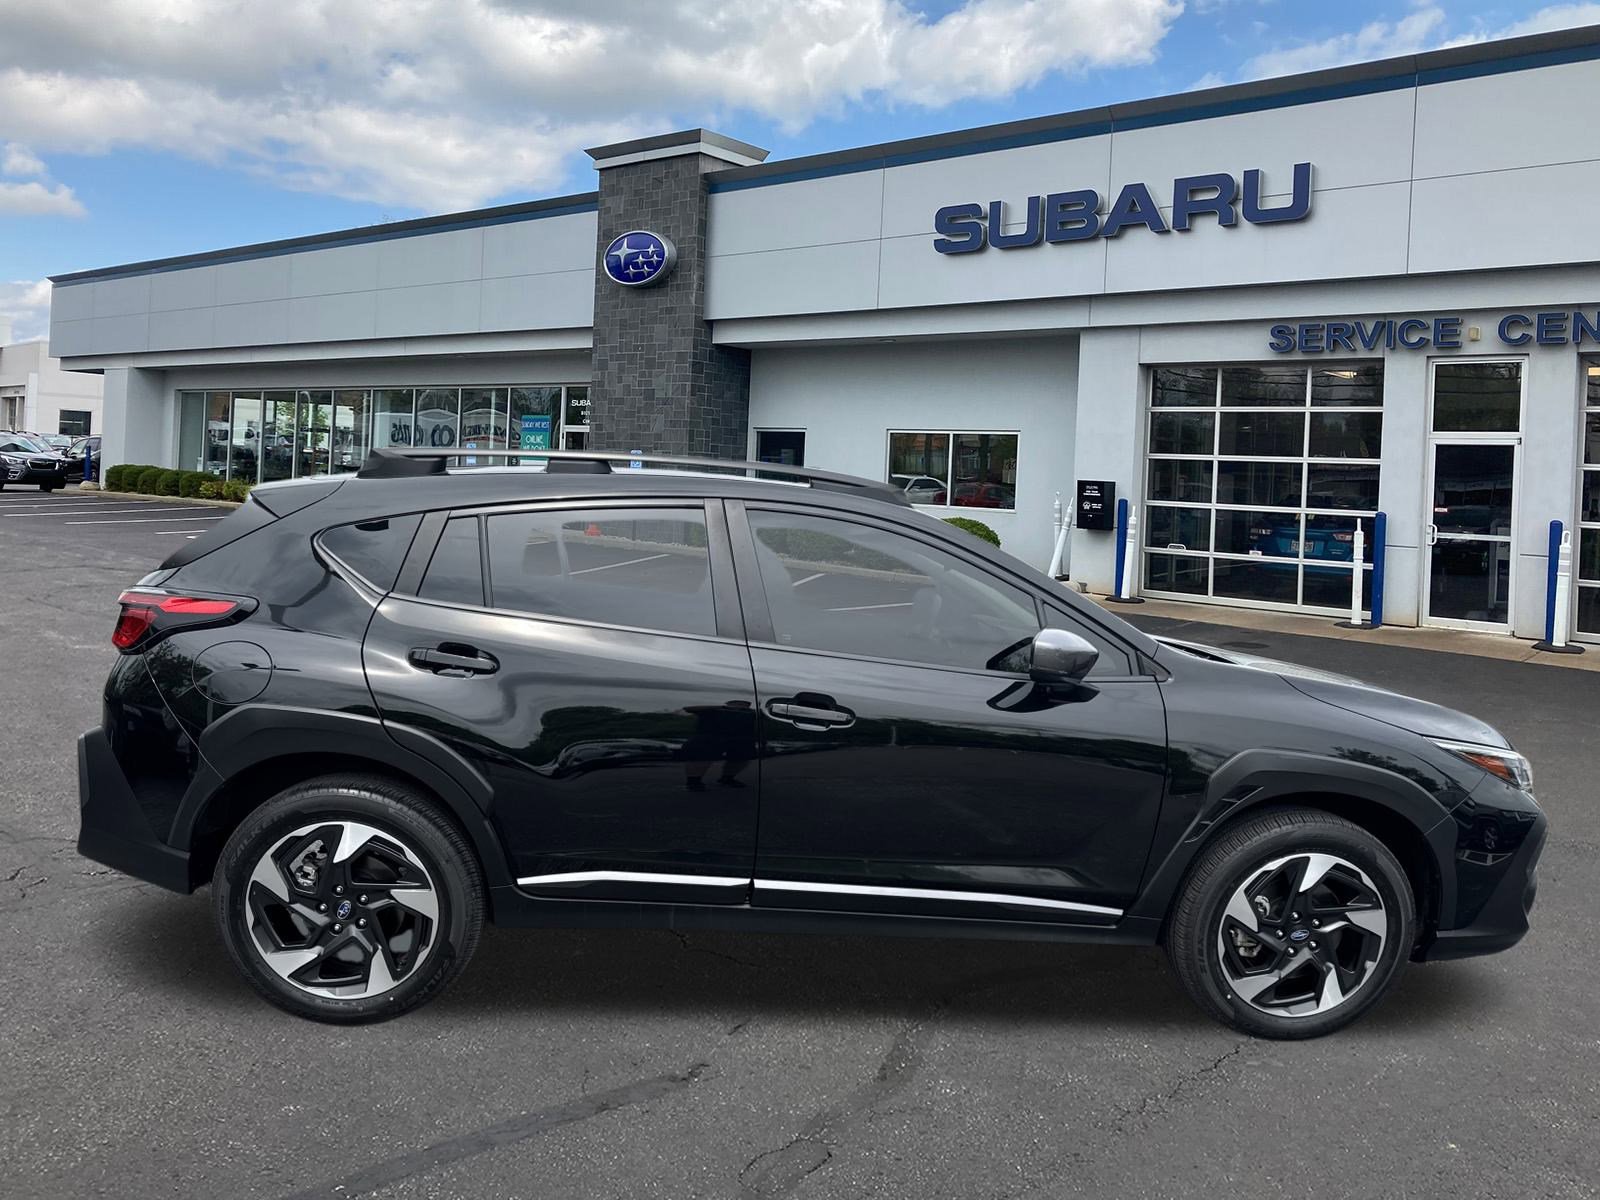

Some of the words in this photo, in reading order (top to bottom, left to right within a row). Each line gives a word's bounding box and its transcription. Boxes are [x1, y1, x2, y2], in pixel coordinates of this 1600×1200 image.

[933, 161, 1313, 255] SUBARU
[1268, 317, 1462, 353] SERVICE
[1497, 311, 1600, 346] CEN
